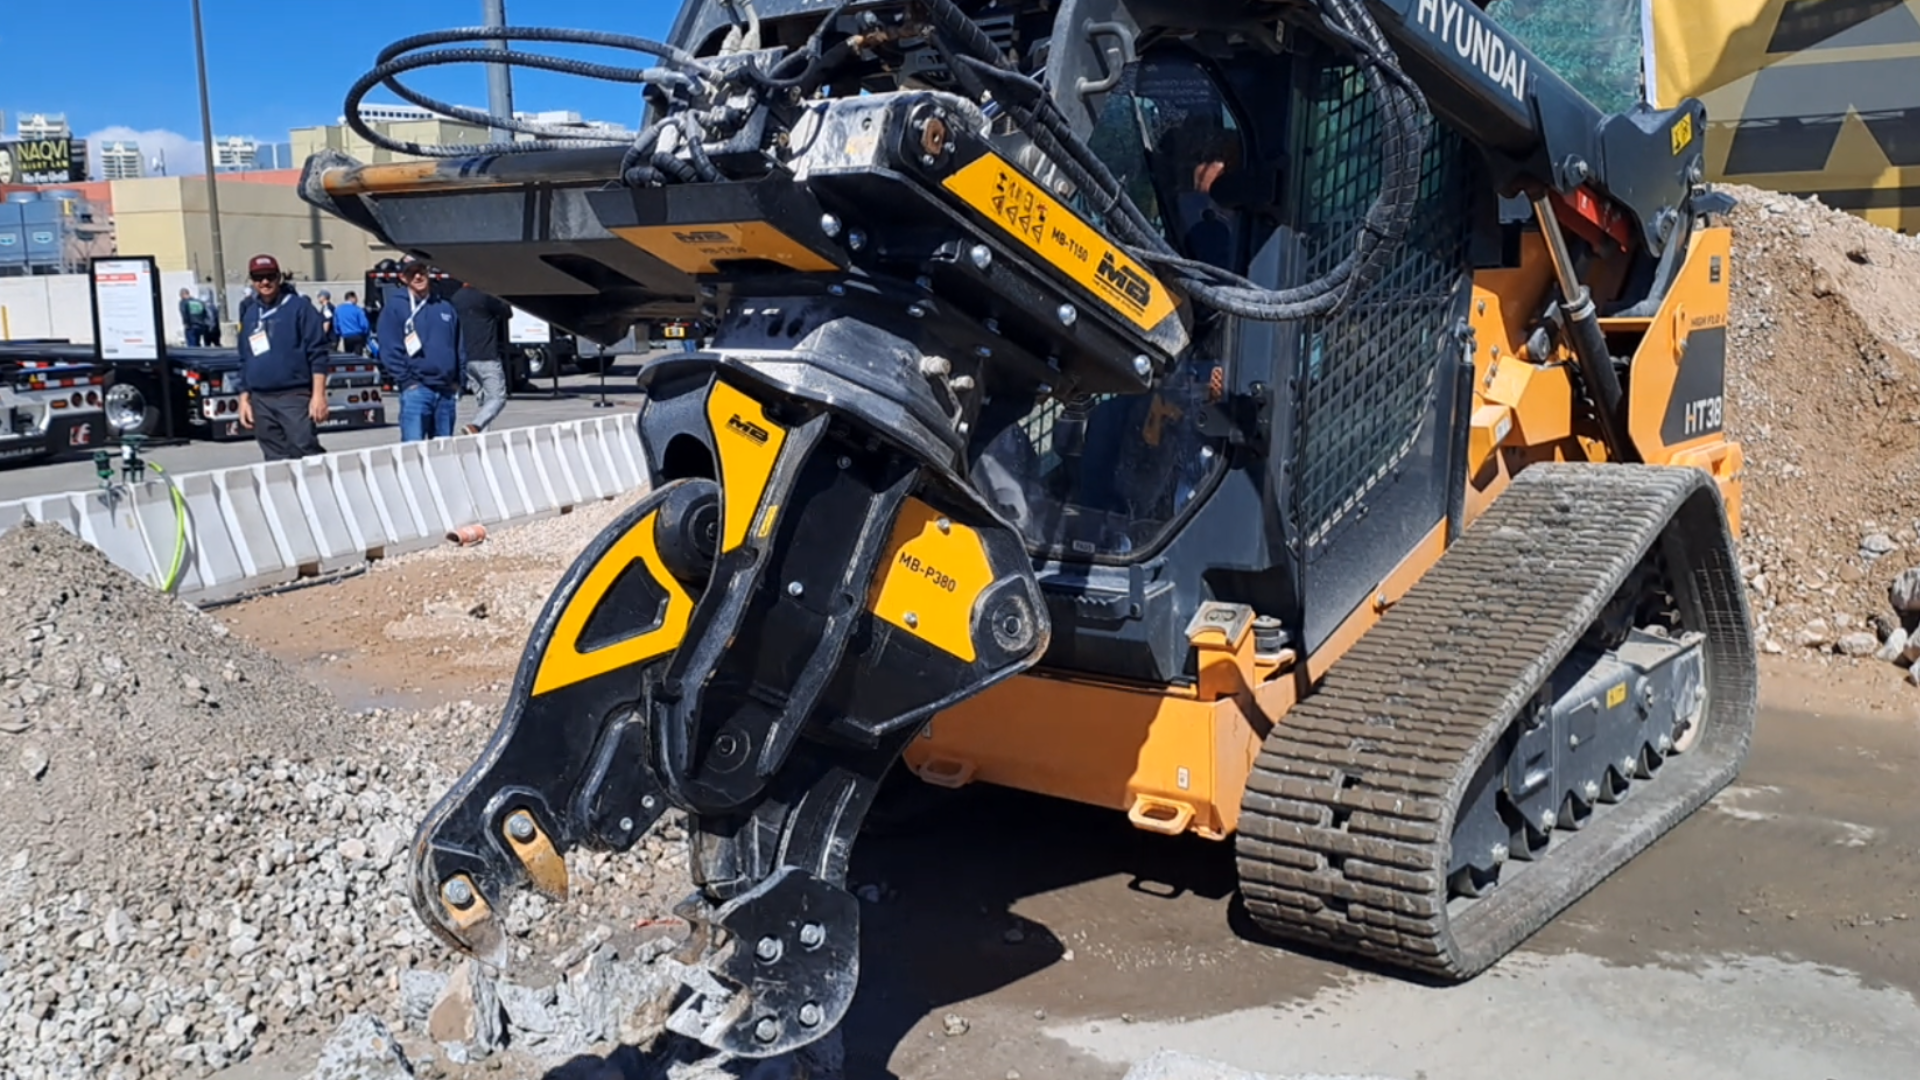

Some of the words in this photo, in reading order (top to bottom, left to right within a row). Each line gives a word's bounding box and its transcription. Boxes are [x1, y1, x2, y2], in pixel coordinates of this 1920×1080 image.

[1417, 0, 1527, 102] HYUNDAI
[16, 140, 70, 162] NAQVI
[1051, 227, 1089, 263] MB-T150
[1096, 251, 1151, 307] MB
[729, 413, 768, 443] MB
[1685, 396, 1723, 435] HT38
[899, 551, 957, 593] MB-P380
